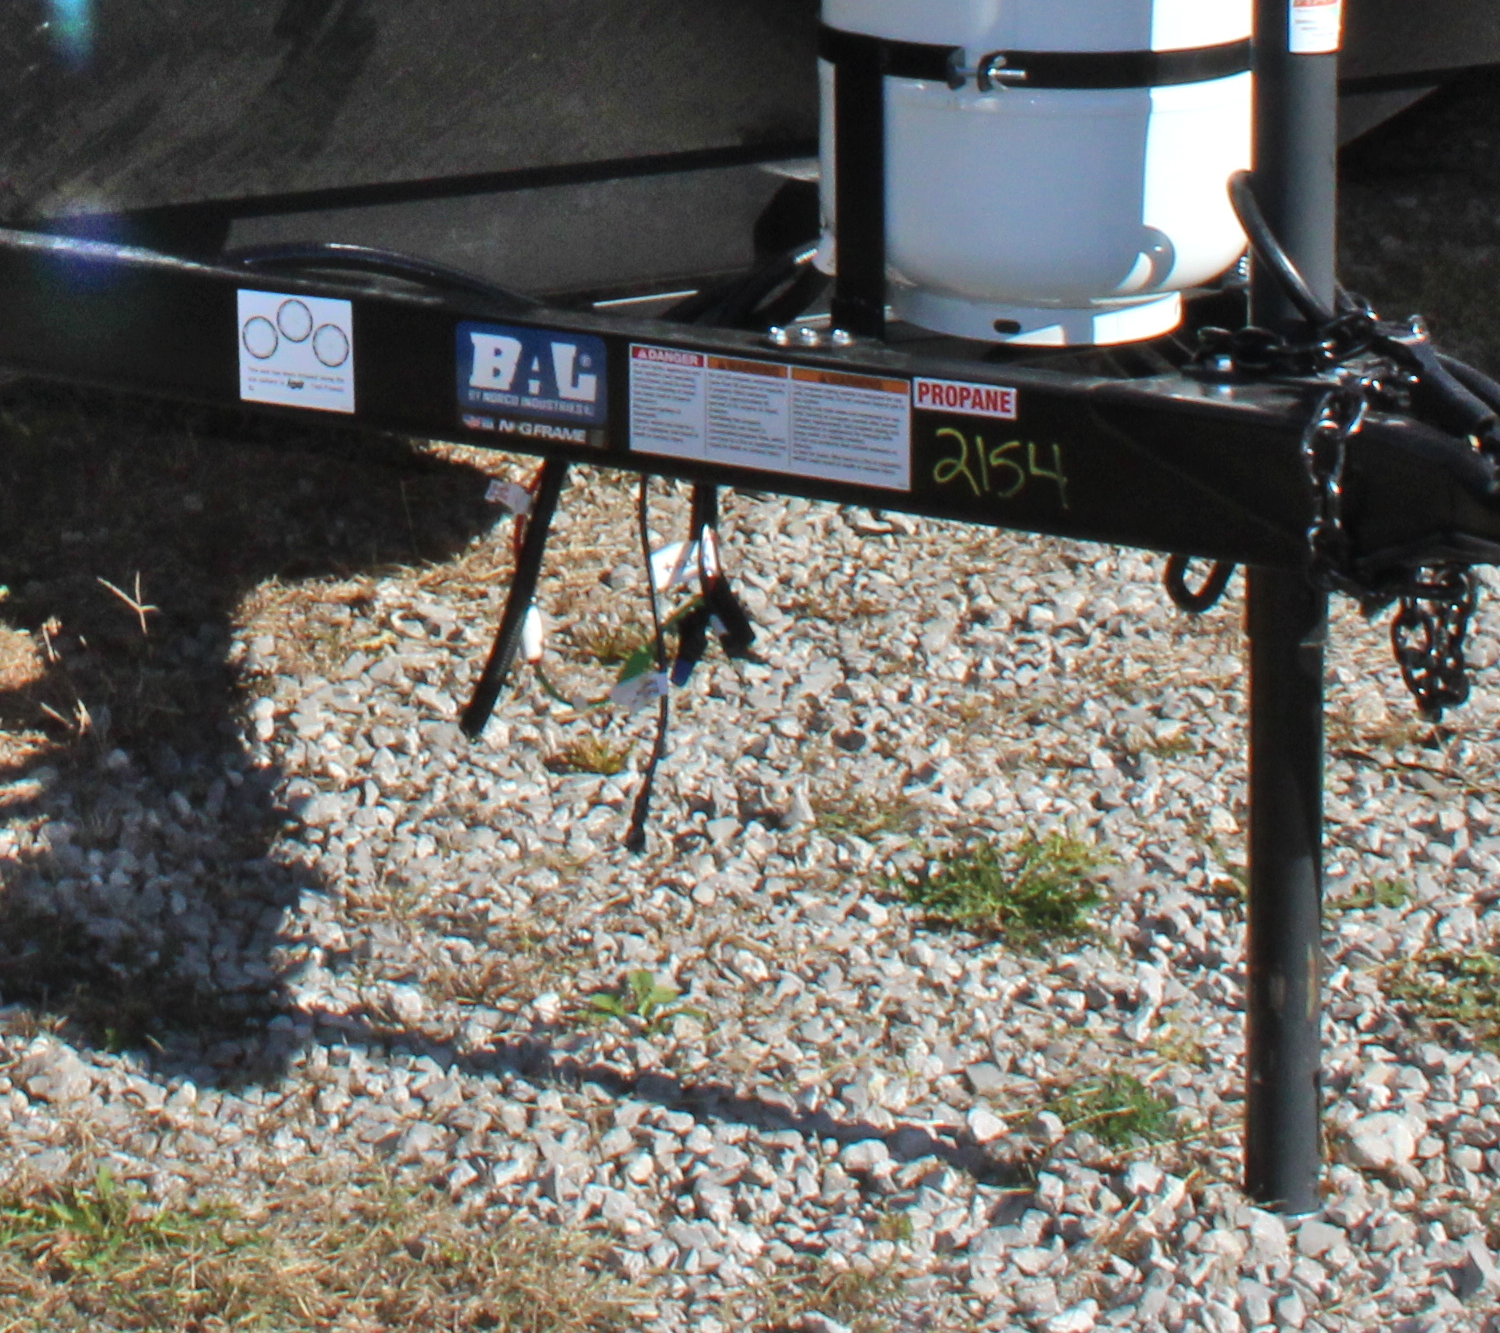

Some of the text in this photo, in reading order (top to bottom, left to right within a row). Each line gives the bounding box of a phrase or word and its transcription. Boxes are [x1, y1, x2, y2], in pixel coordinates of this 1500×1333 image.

[468, 331, 598, 404] BAL
[649, 349, 700, 367] DANGER
[917, 381, 1012, 414] PROPANE
[933, 427, 1068, 510] 2154
